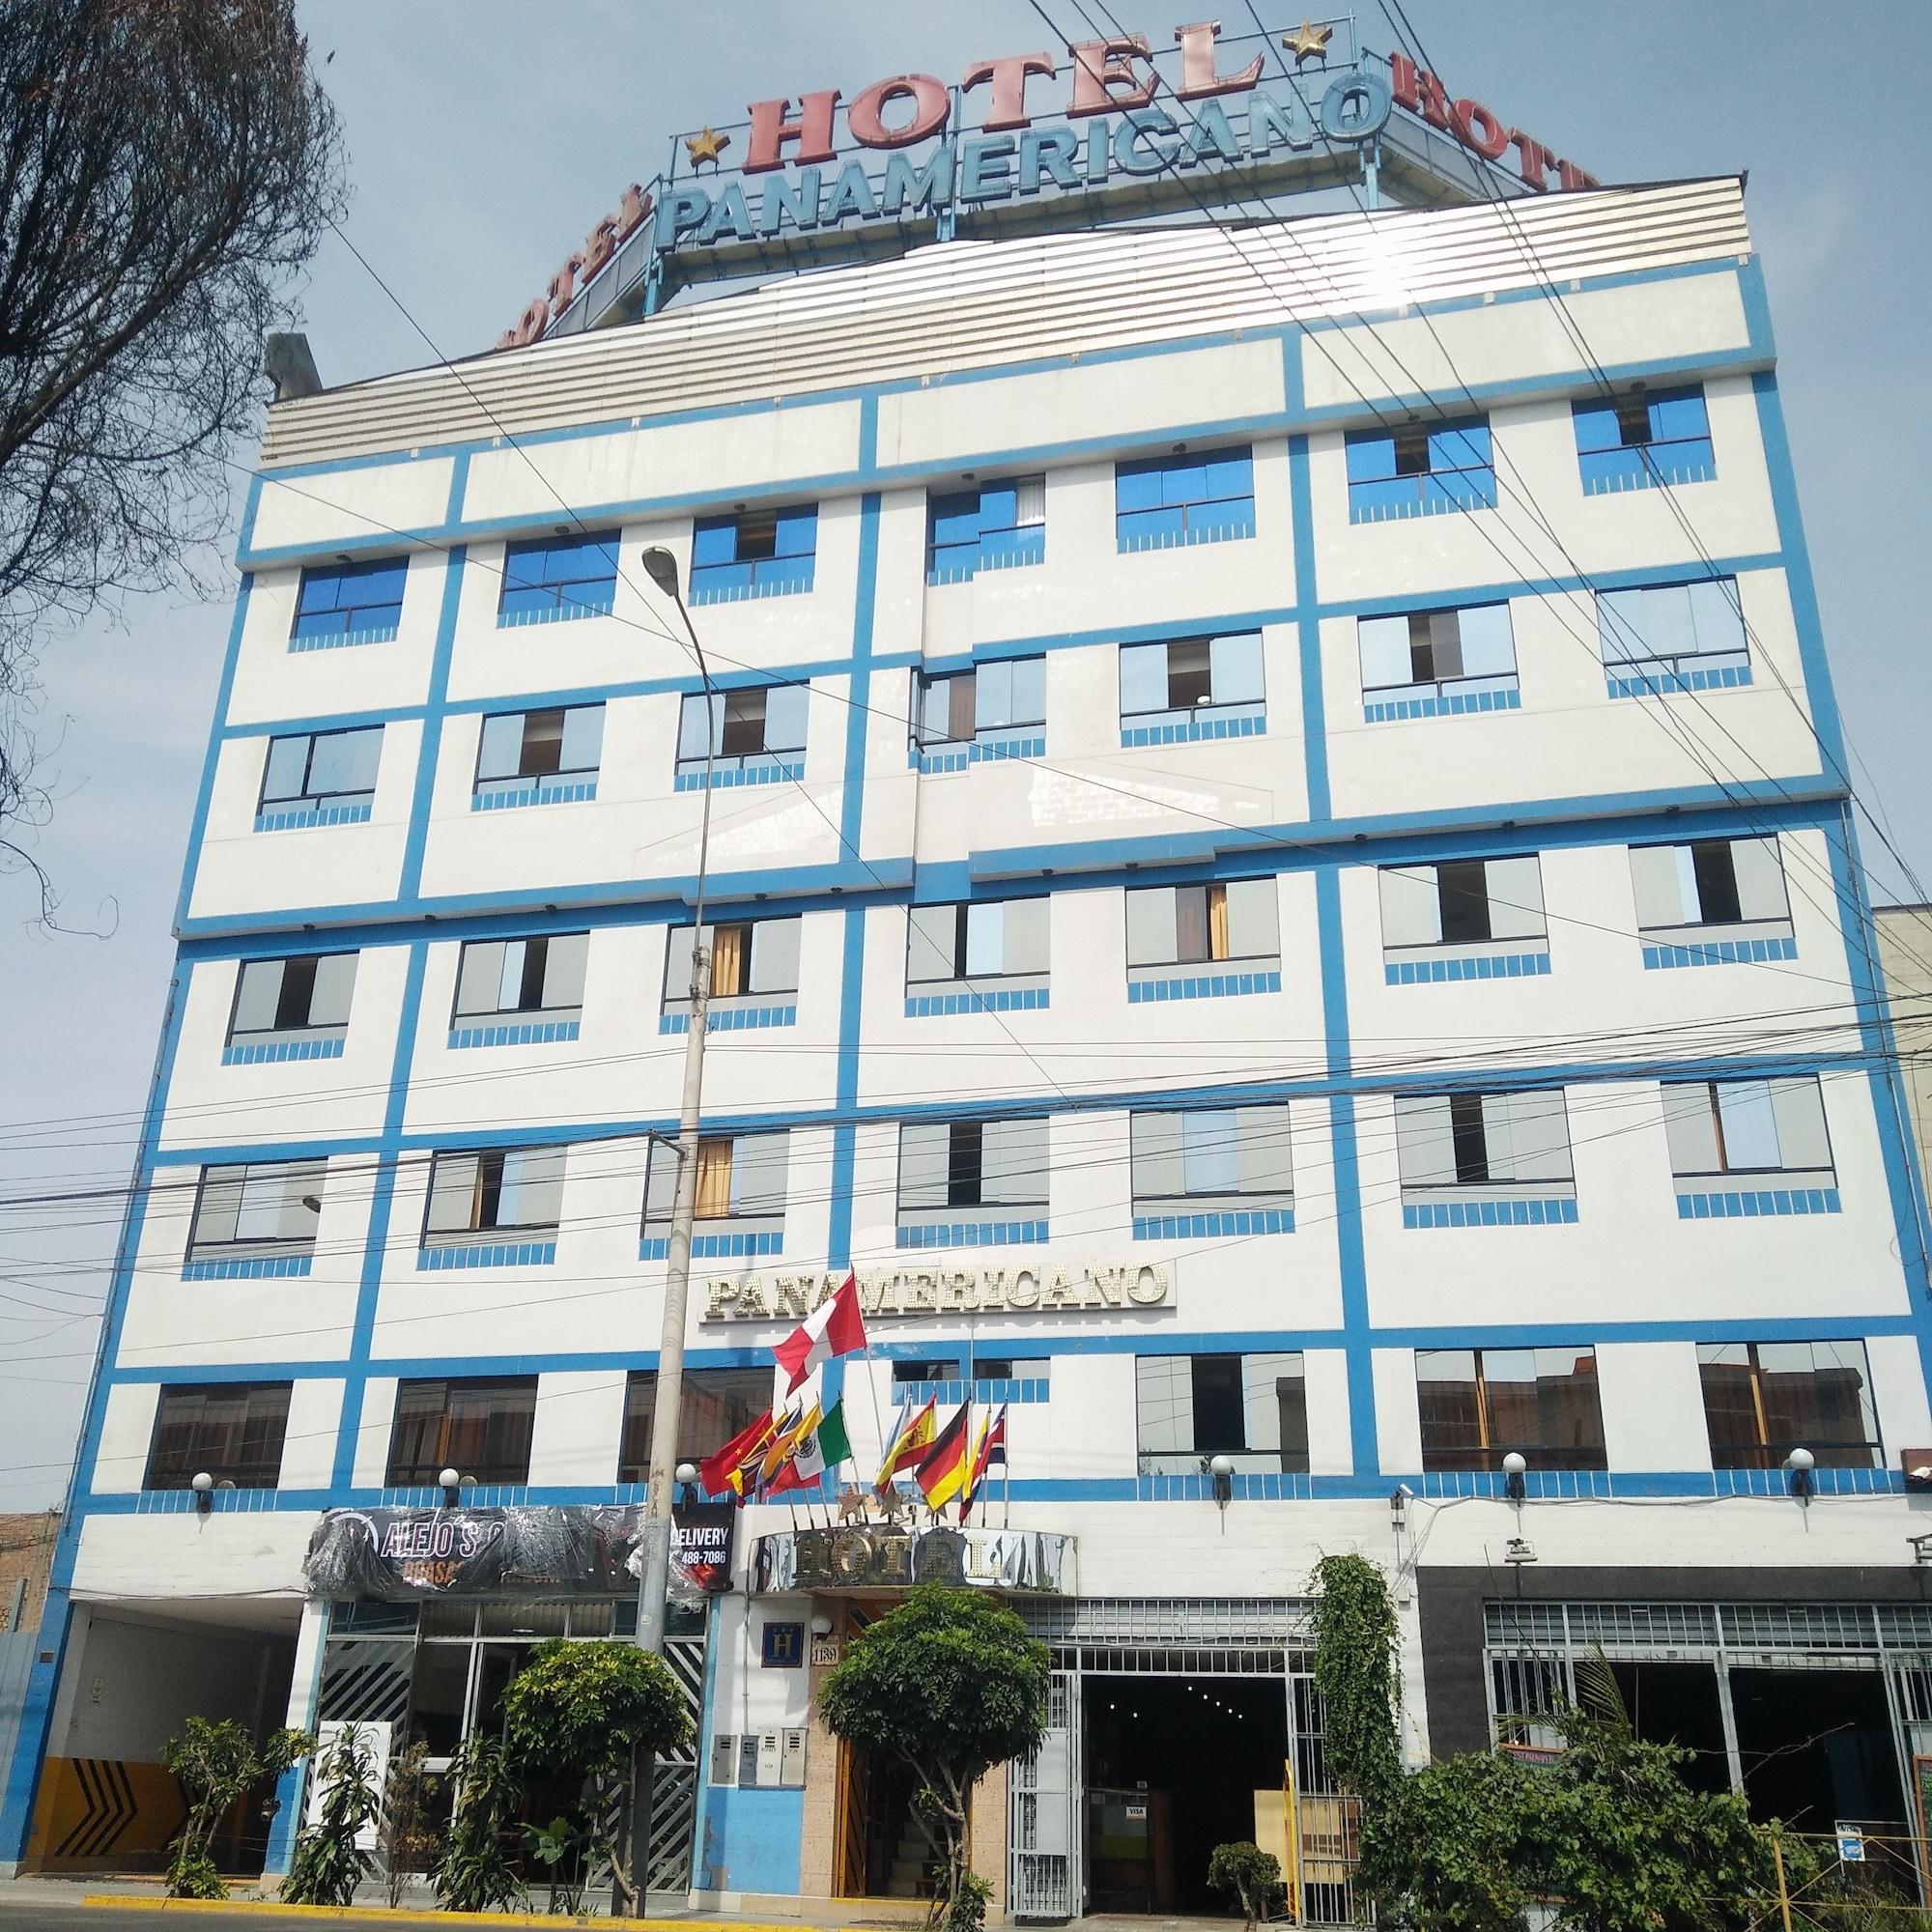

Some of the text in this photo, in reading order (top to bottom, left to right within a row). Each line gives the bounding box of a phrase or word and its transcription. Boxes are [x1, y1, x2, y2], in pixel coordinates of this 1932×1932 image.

[741, 18, 1264, 174] HOTEL
[655, 72, 1392, 252] PANAMERICANO
[704, 1261, 1167, 1317] PANAMERICANO
[682, 1550, 726, 1565] 488-7086
[792, 1533, 1002, 1579] HOTEL
[773, 1634, 793, 1658] H
[814, 1647, 837, 1662] 1139
